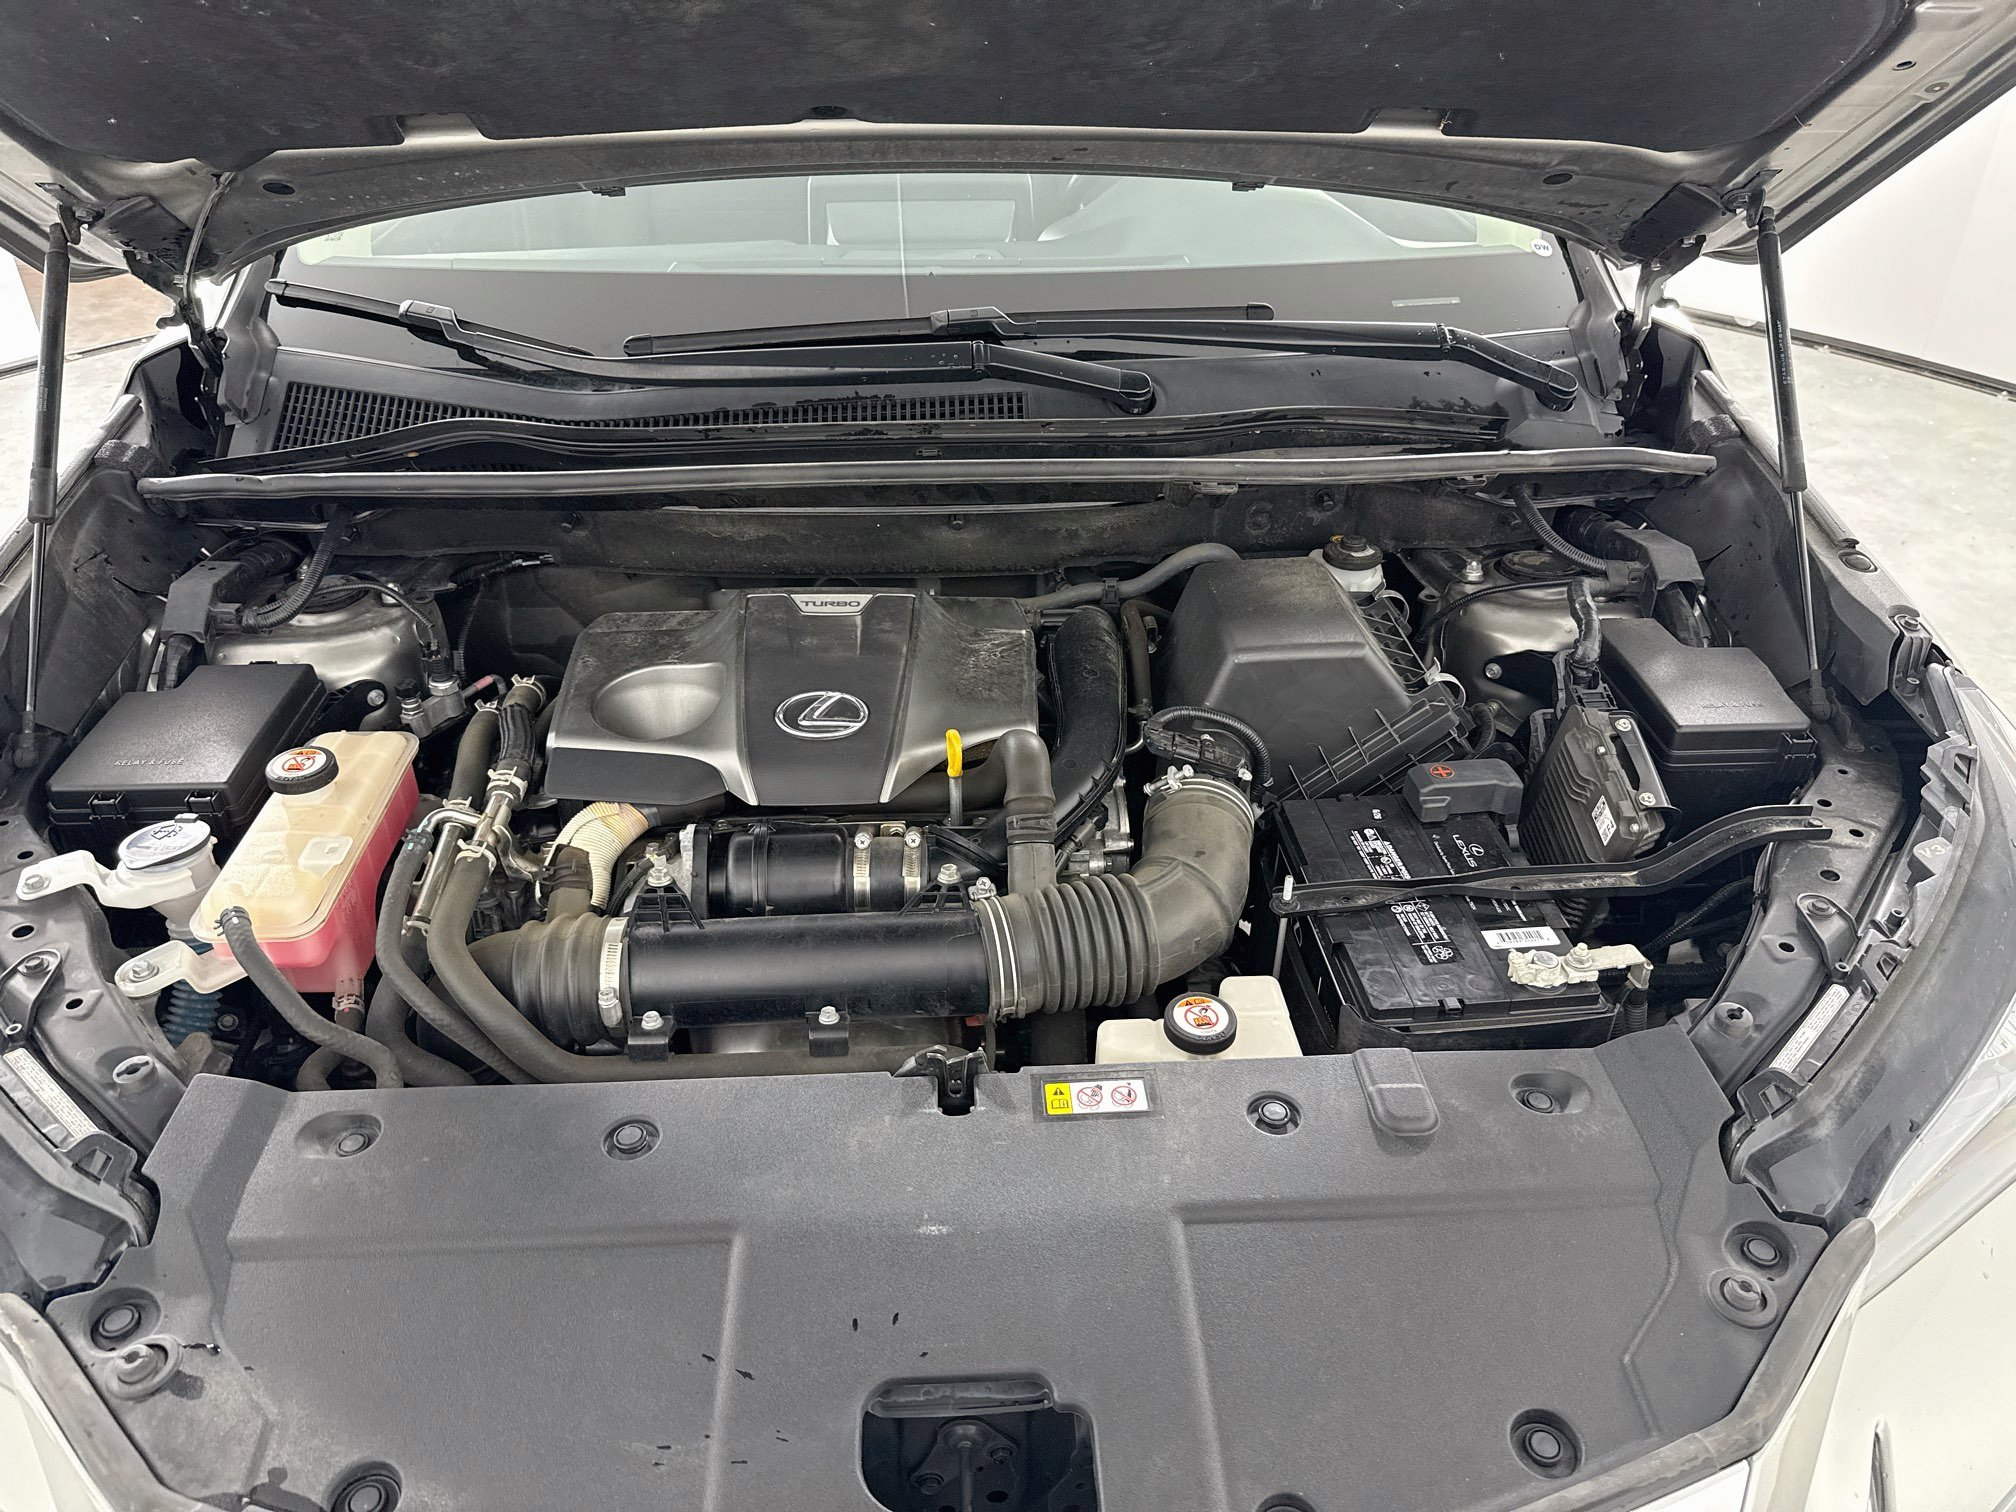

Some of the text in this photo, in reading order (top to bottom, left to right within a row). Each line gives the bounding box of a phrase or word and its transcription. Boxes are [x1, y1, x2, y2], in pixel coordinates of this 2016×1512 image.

[1533, 243, 1550, 252] DW
[114, 759, 148, 767] RELAY
[158, 757, 186, 766] FUSE
[1452, 834, 1478, 868] LEXUS
